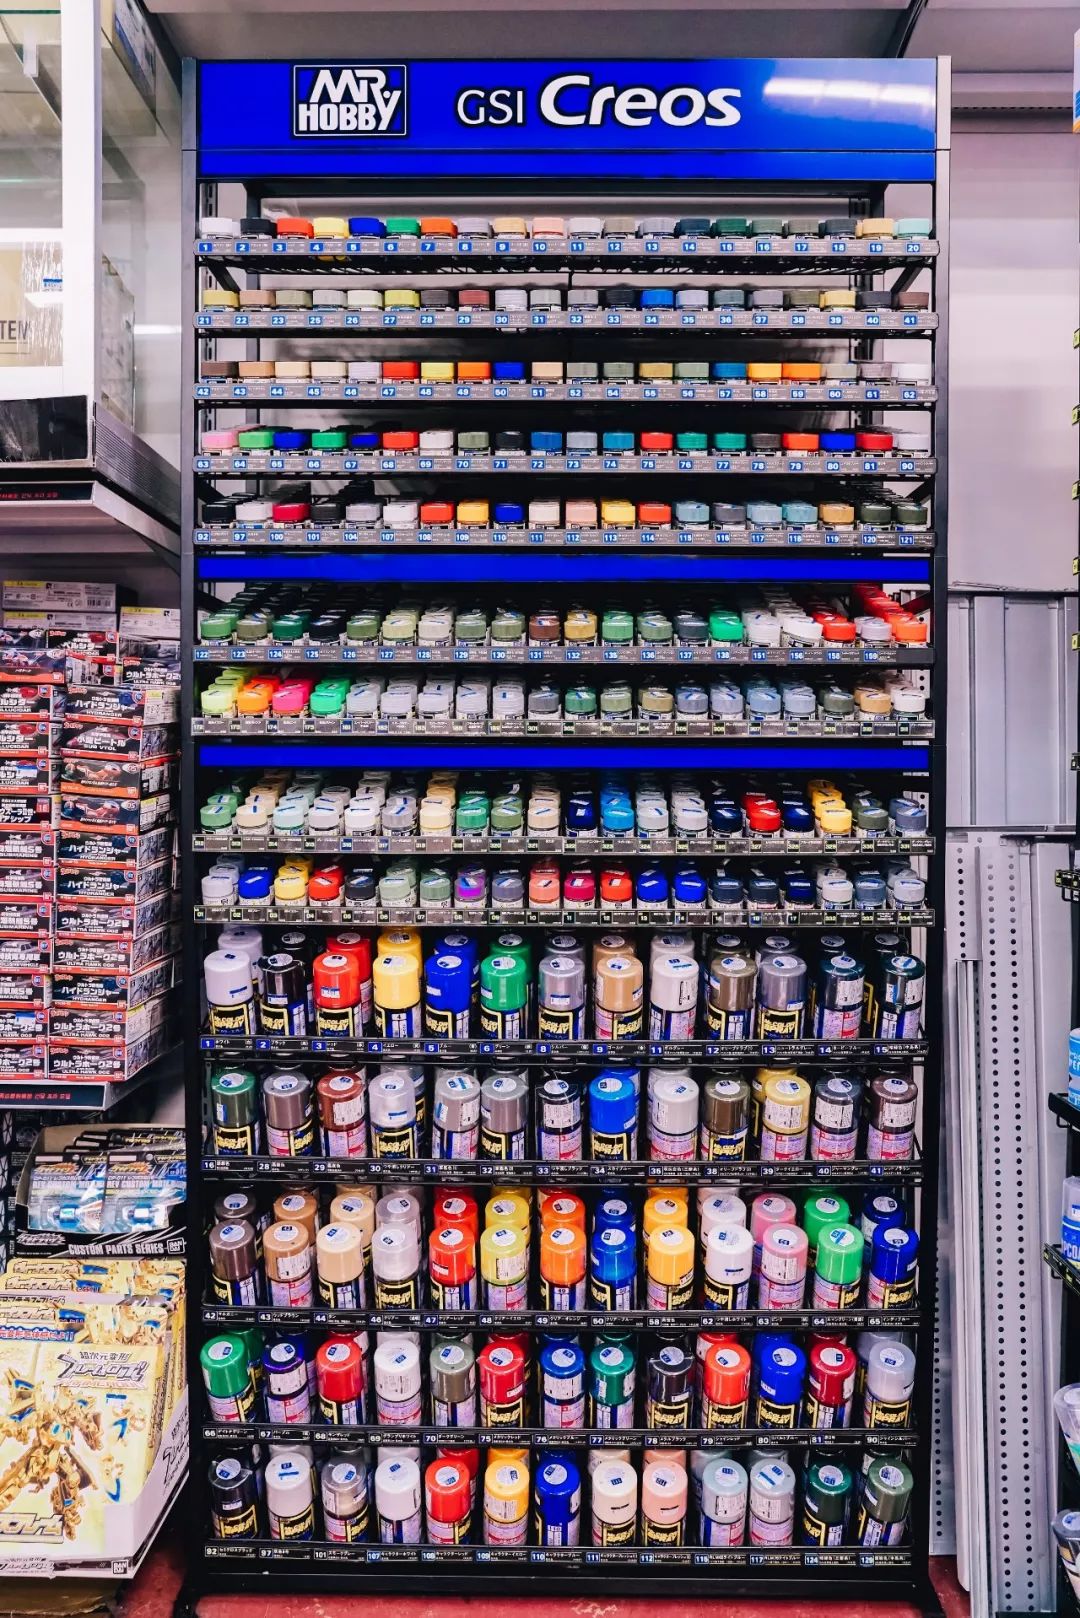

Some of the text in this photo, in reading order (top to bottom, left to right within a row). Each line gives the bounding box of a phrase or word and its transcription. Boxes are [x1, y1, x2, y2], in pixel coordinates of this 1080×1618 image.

[298, 90, 402, 132] HOBBY
[456, 74, 743, 127] GSI Creos
[68, 1242, 164, 1255] CUSTOM PARTS SERIES
